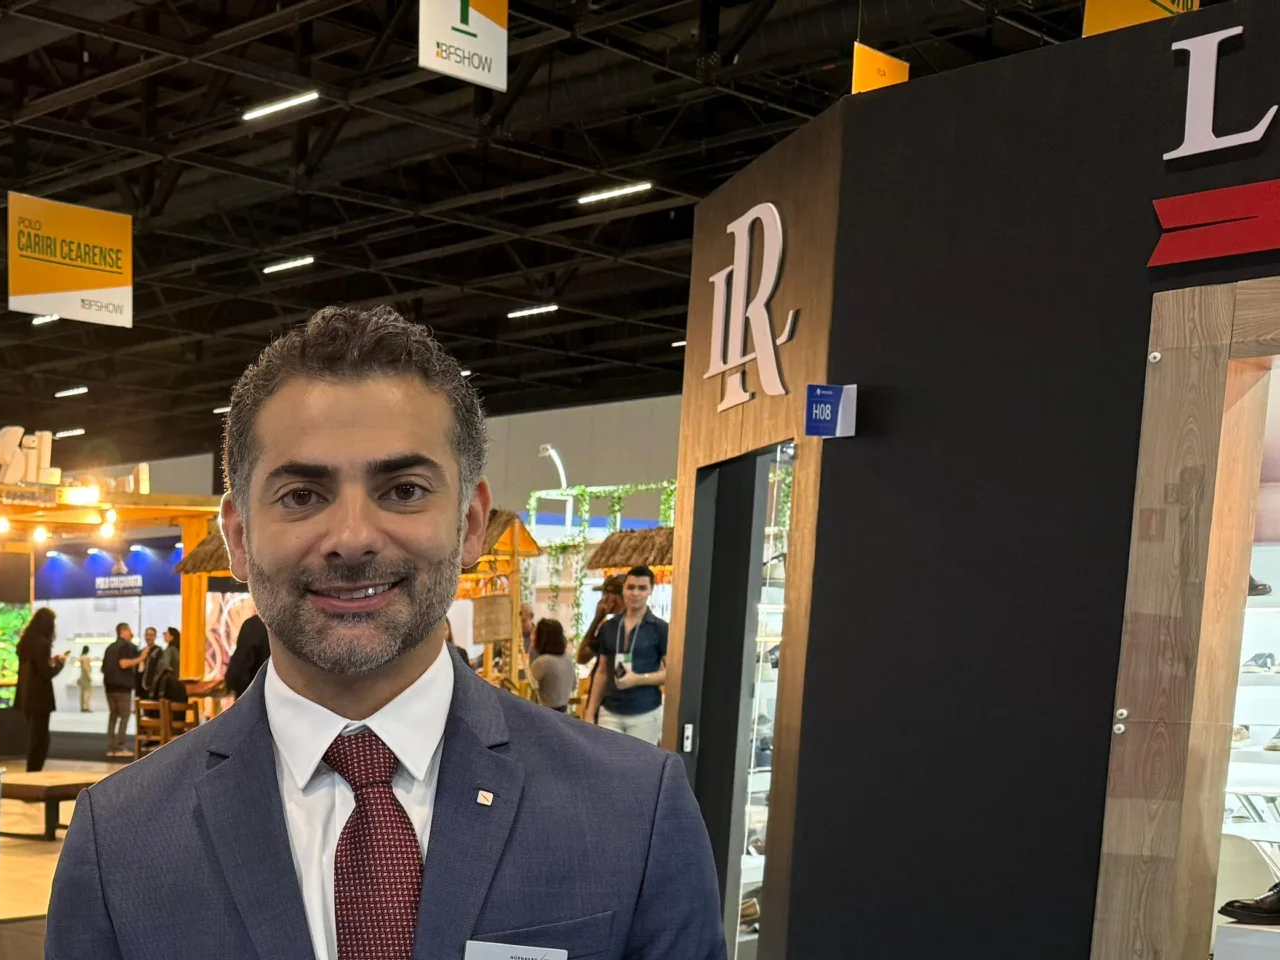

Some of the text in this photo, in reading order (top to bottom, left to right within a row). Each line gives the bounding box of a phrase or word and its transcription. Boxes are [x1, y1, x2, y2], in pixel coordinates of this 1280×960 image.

[439, 42, 493, 74] BFSHOW
[18, 216, 42, 232] POLO
[17, 229, 124, 270] CARIRI CEARENSE
[812, 403, 832, 421] H08
